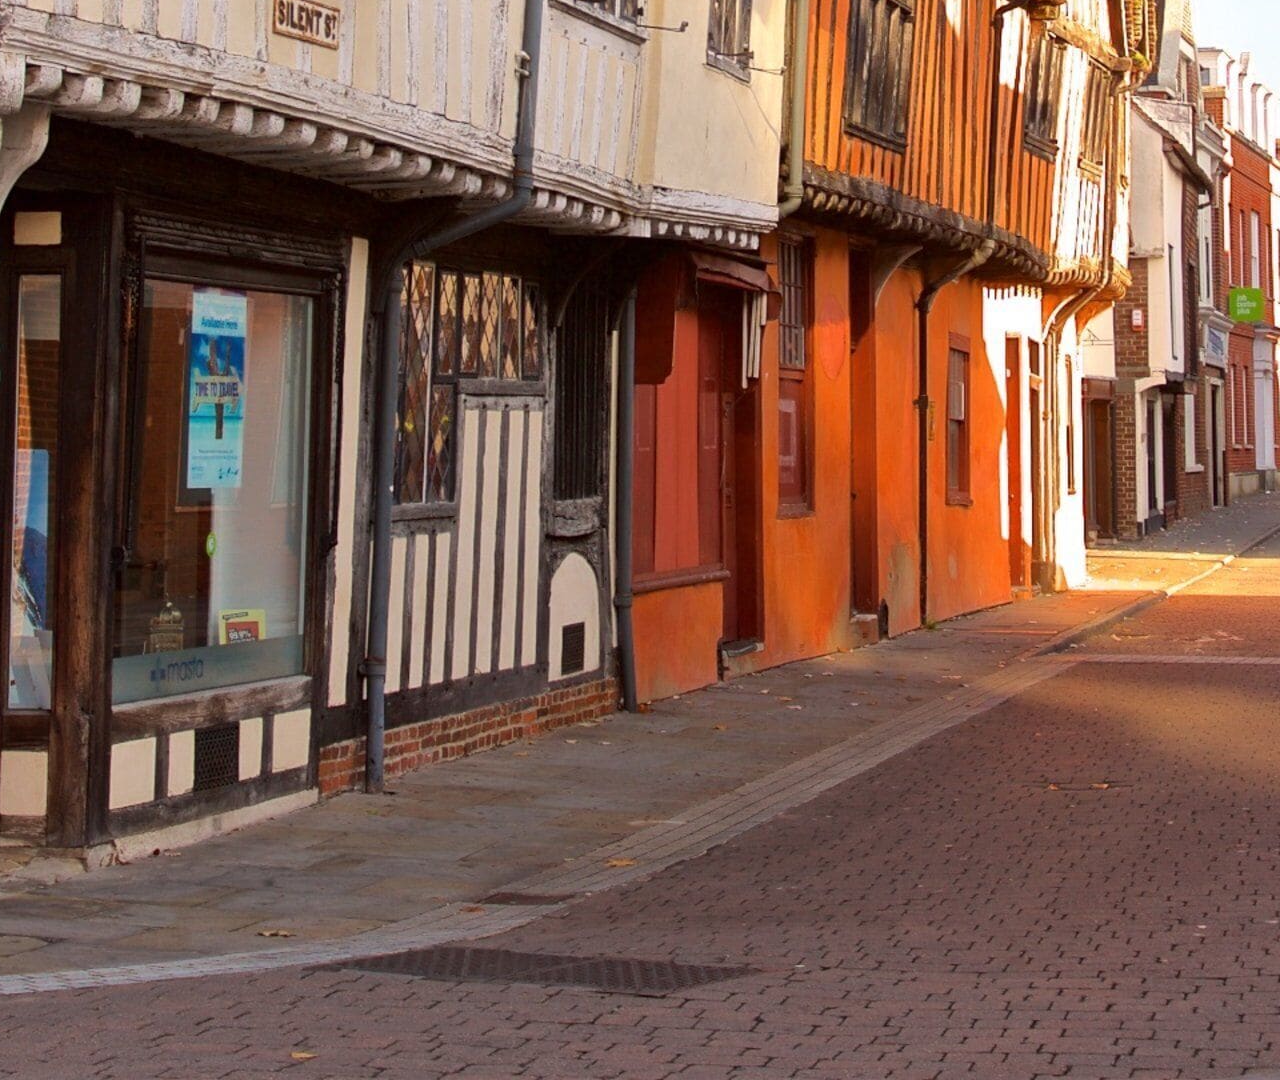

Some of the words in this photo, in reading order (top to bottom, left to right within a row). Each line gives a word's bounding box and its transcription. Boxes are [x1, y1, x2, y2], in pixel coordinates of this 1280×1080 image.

[278, 0, 323, 36] SILENT
[195, 382, 208, 397] TIME
[167, 656, 204, 682] masta
